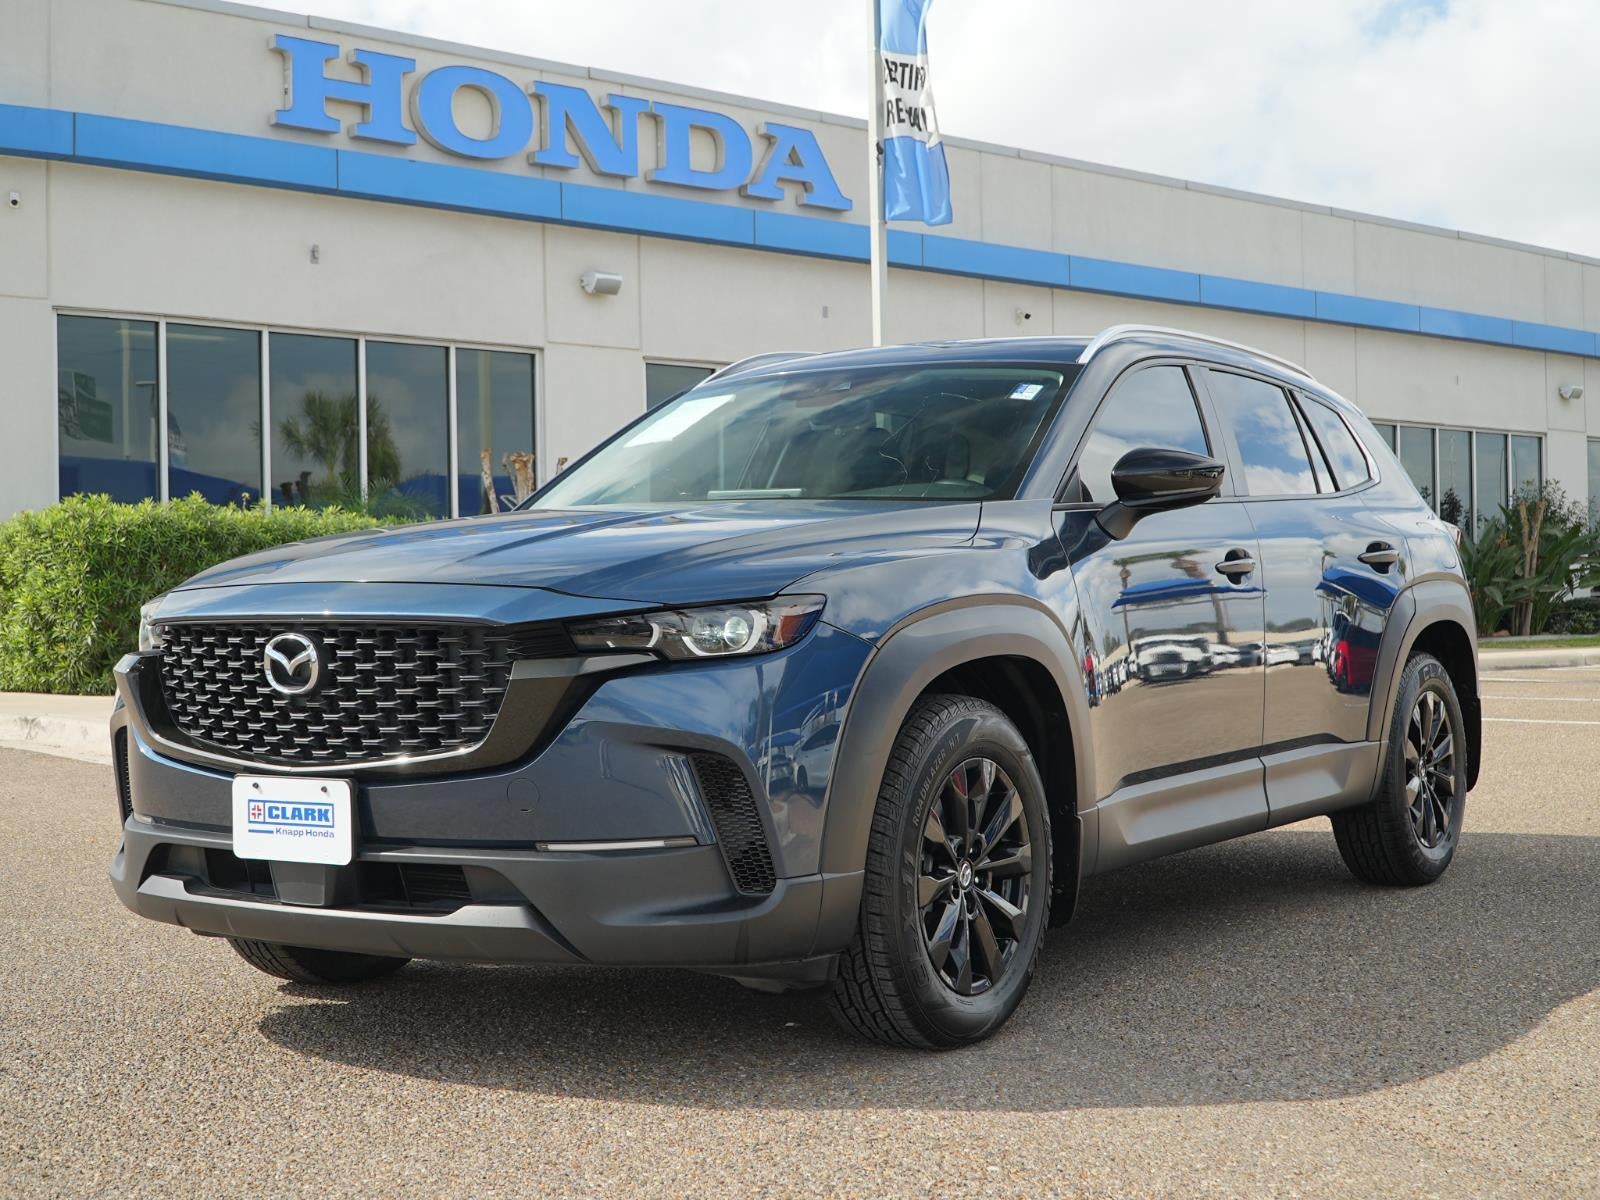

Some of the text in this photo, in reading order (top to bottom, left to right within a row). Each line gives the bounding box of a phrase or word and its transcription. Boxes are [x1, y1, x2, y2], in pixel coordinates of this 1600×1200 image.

[269, 34, 853, 211] HONDA
[268, 805, 330, 822] CLARK
[275, 828, 335, 838] Knapp Honda
